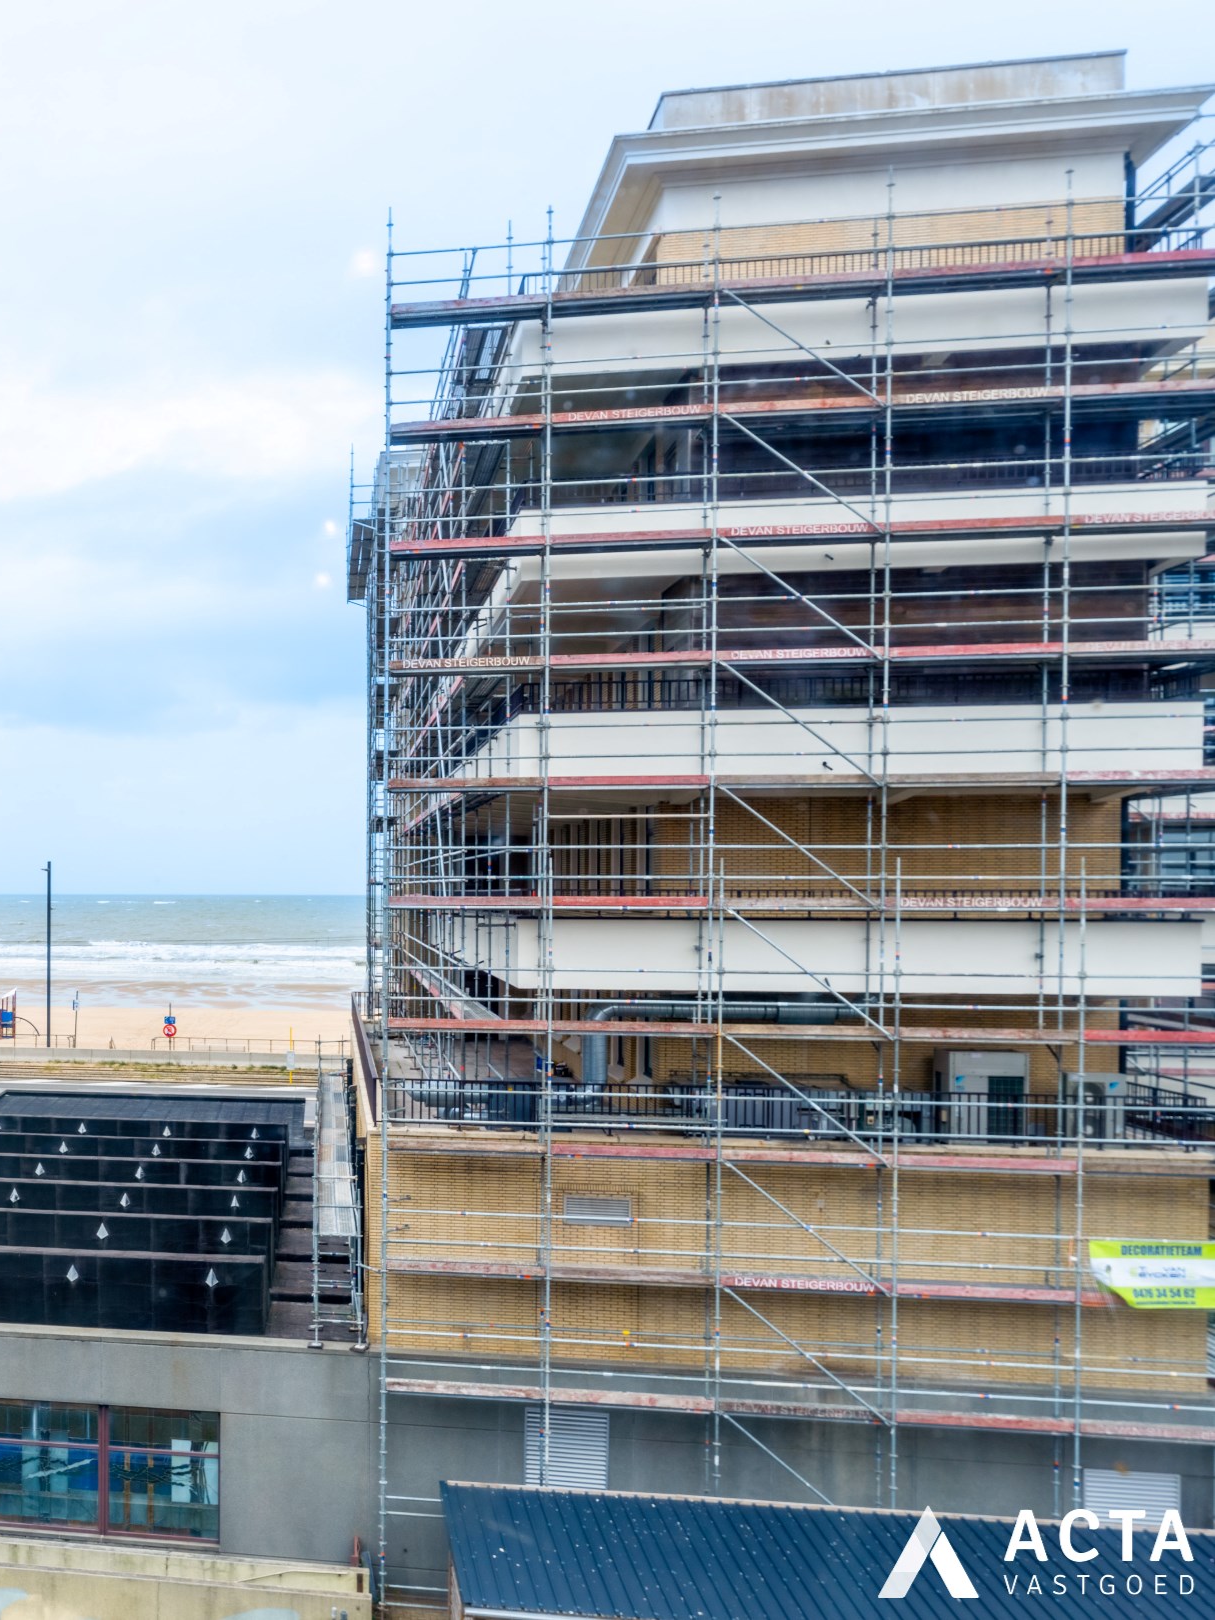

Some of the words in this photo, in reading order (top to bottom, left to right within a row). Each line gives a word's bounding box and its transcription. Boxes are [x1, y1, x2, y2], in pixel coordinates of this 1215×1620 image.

[906, 392, 949, 404] DEVAN
[953, 387, 1048, 401] STEIGERBOUW
[568, 410, 608, 421] DEVAN
[612, 404, 701, 418] STEIGERBOUW
[731, 526, 772, 536] DEVAN
[777, 523, 868, 535] STEIGERBOUW
[731, 650, 772, 660] DEVAN
[776, 647, 867, 659] STEIGERBOUW
[402, 659, 441, 669] DEVAN
[444, 656, 530, 667] STEIGERBOUW
[901, 897, 943, 907] DEVAN
[947, 897, 1043, 908] STEIGERBOUW
[1121, 1245, 1202, 1256] DECORATIETEAM
[734, 1277, 777, 1288] DEVAN
[781, 1279, 875, 1292] STEIGERBOUW
